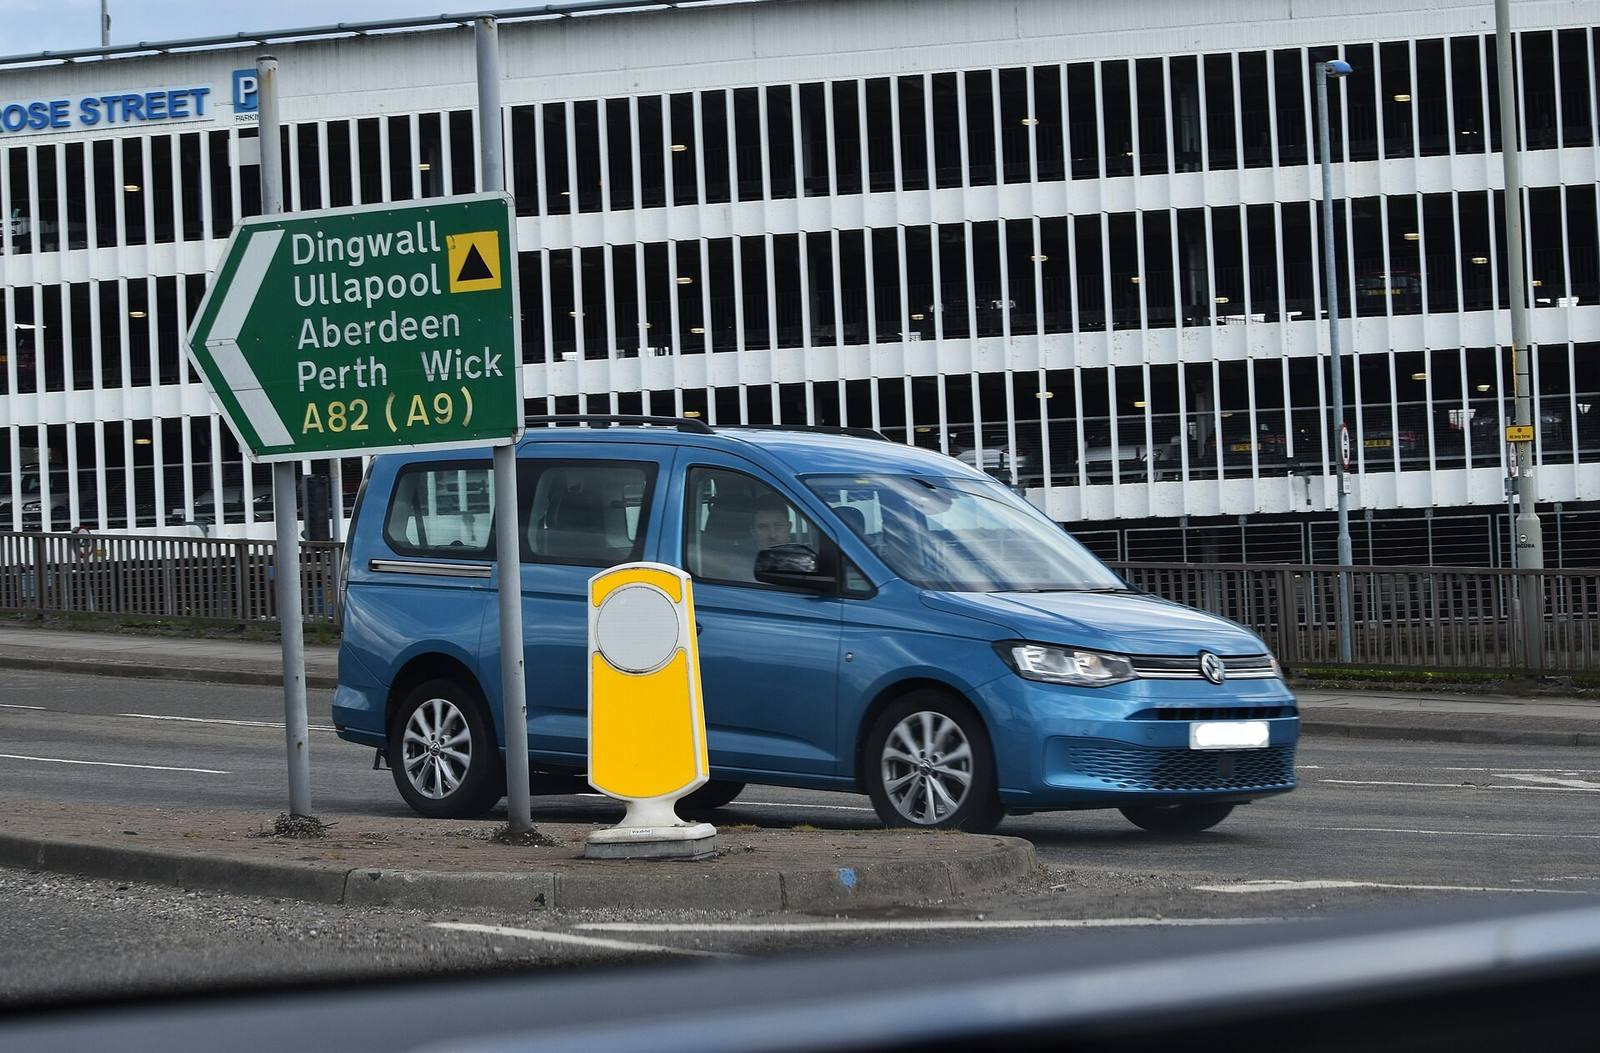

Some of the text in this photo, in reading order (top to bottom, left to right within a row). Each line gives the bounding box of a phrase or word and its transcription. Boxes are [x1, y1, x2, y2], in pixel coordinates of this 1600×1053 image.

[0, 87, 210, 132] OSE STREET
[240, 76, 258, 104] P
[235, 113, 258, 121] PARKI
[292, 220, 441, 266] Dingwall
[294, 263, 442, 309] Ullapool
[297, 311, 460, 349] Aberdeen
[298, 347, 504, 392] Perth Wick
[302, 399, 369, 434] A82
